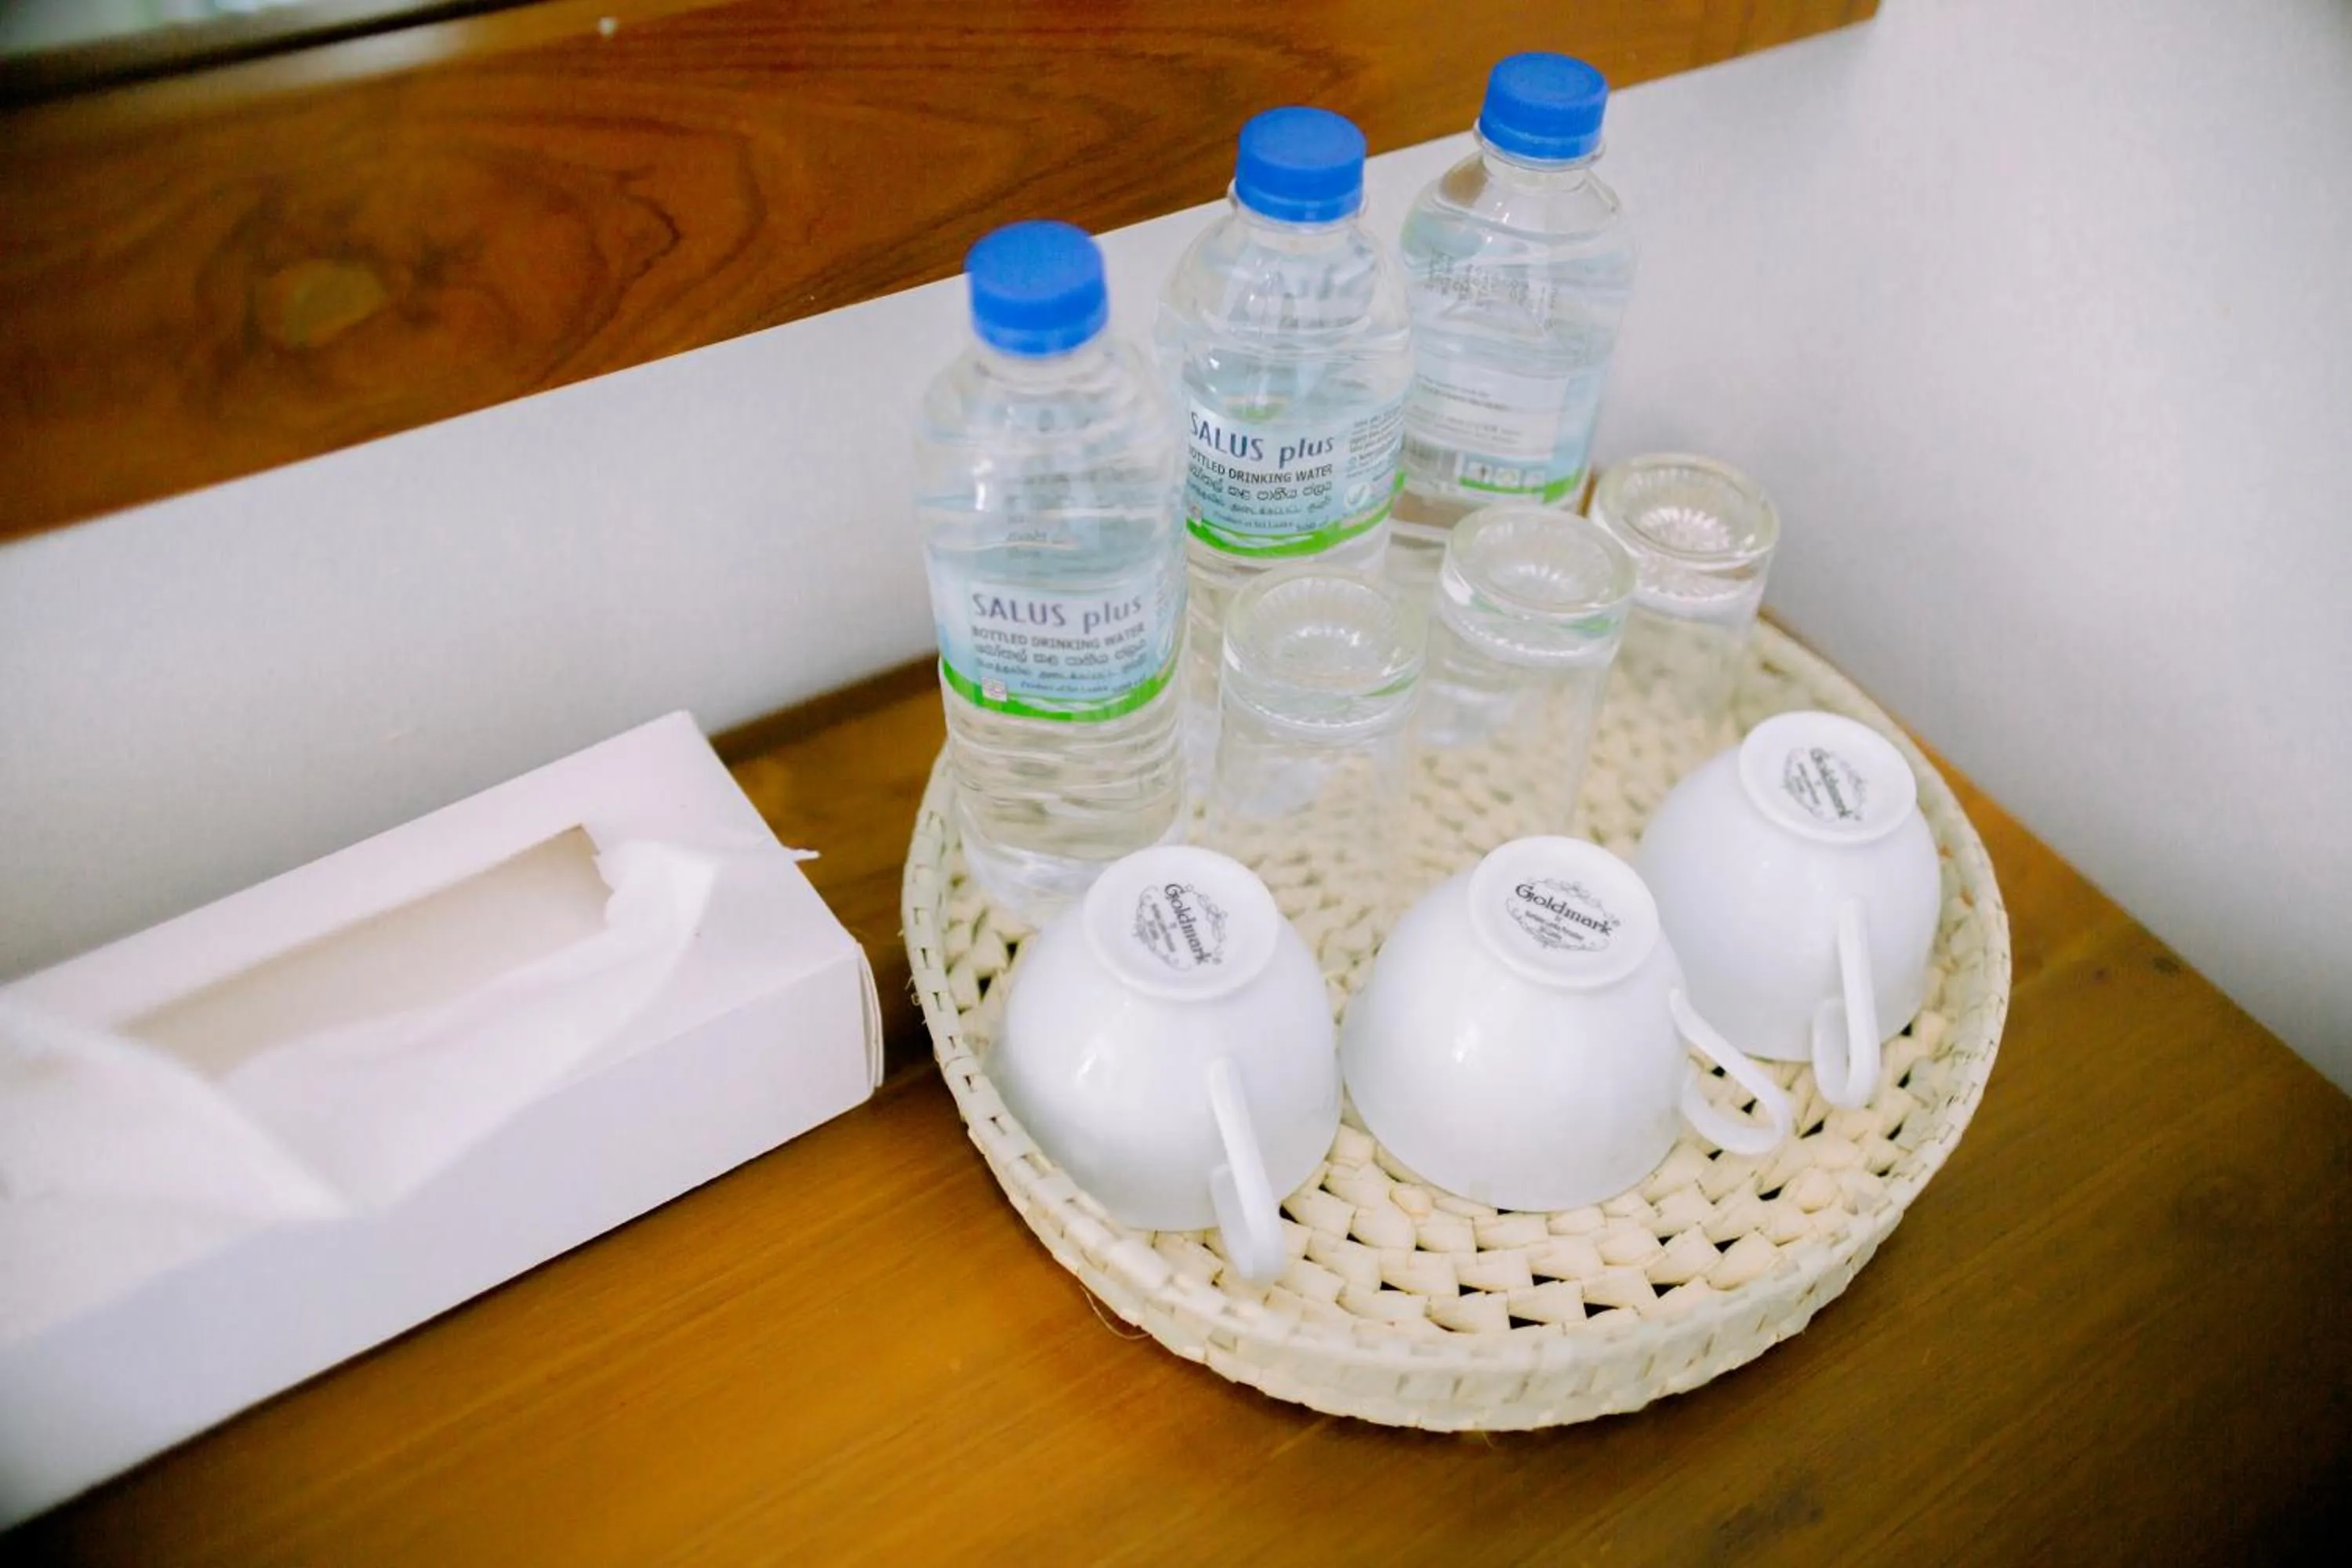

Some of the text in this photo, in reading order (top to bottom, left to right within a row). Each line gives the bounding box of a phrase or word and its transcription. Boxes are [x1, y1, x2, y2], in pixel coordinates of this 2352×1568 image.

[1190, 411, 1264, 462] SALUS
[1279, 435, 1335, 470] plus
[1229, 469, 1292, 485] DRINKING
[1295, 463, 1333, 483] WATER
[971, 622, 1145, 650] BOTTLED DRINKING WATER
[972, 593, 1067, 627] SALUS
[1083, 595, 1142, 635] plus
[1164, 883, 1213, 966] Goldmark
[1515, 884, 1613, 936] Goldmark
